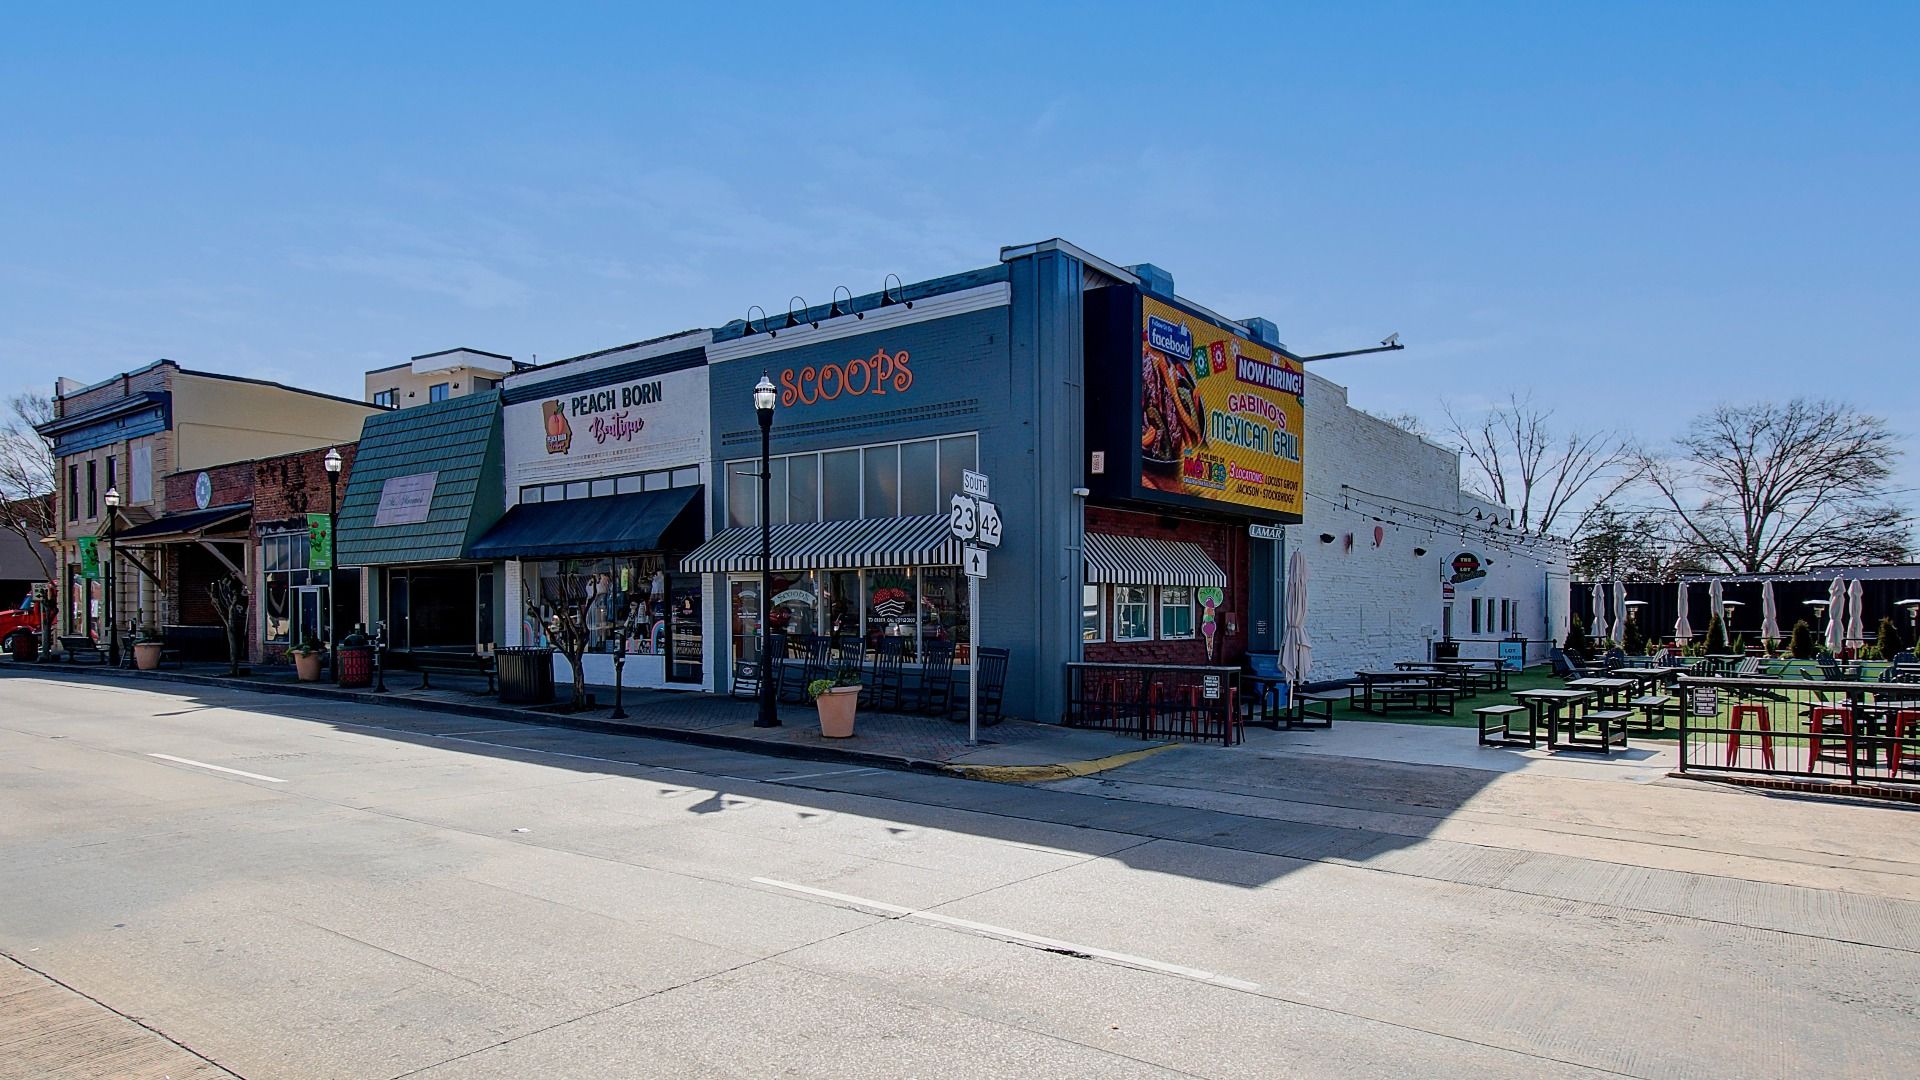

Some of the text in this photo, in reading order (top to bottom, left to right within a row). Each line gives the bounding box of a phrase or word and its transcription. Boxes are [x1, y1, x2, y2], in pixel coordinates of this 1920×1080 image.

[1152, 328, 1190, 357] facebook
[780, 348, 913, 407] SCOOPS
[1239, 358, 1302, 394] NOW HIRING!
[572, 381, 662, 417] PEACH BORN
[1228, 394, 1286, 429] GABINO'S
[589, 410, 645, 444] Boutique
[1211, 410, 1299, 461] MEXICAN GRILL
[964, 474, 987, 493] SOUTH
[1229, 461, 1236, 478] 3
[1236, 483, 1260, 497] JACKSON
[953, 504, 974, 532] 23
[981, 514, 999, 537] 42
[1251, 526, 1282, 539] LAMAR
